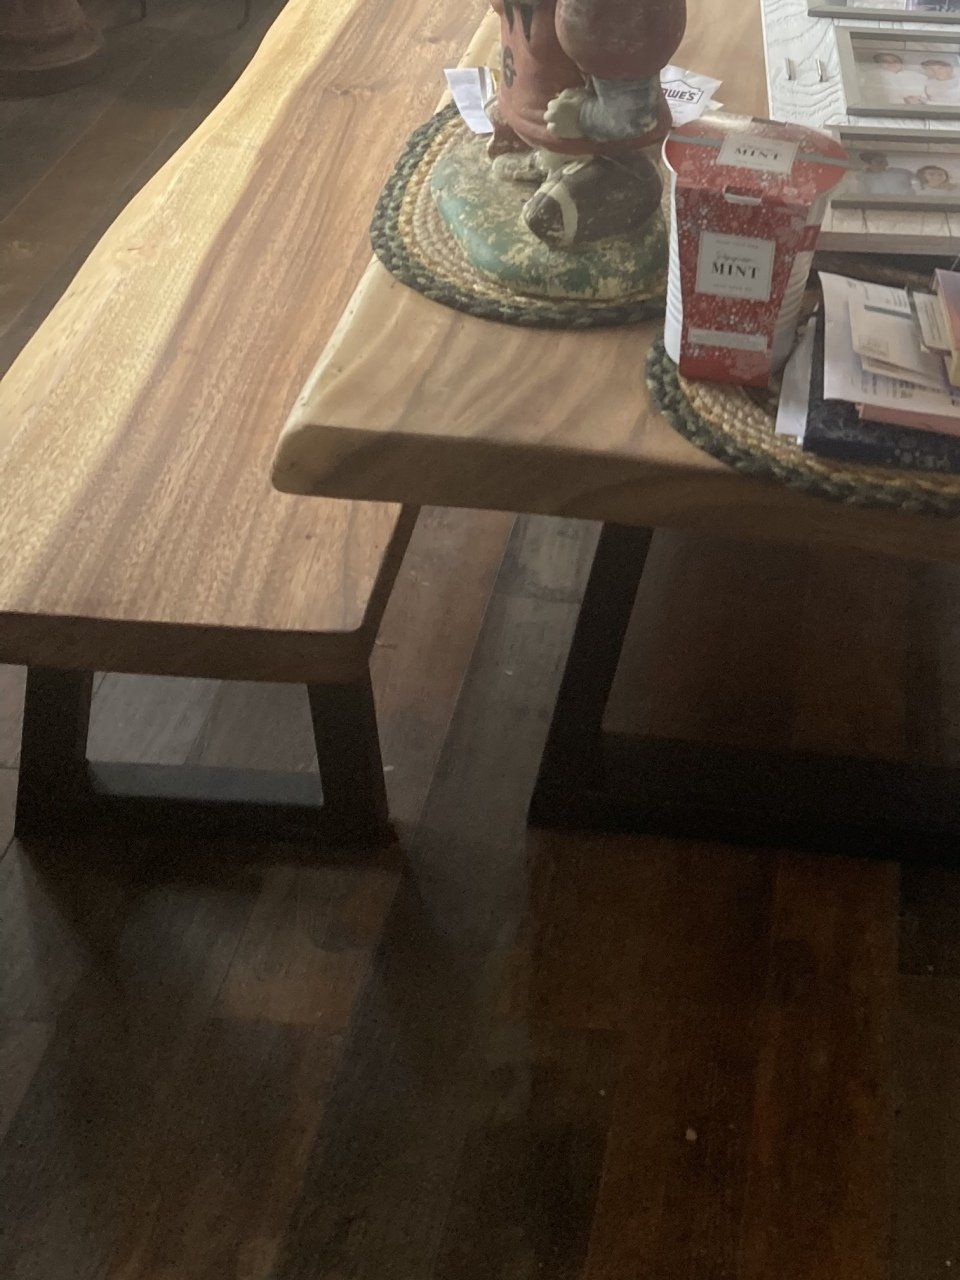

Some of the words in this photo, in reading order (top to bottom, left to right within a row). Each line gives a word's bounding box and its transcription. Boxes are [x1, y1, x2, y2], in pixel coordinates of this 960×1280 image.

[664, 88, 696, 101] WE'S
[735, 146, 779, 161] MINT
[711, 261, 760, 280] MINT
